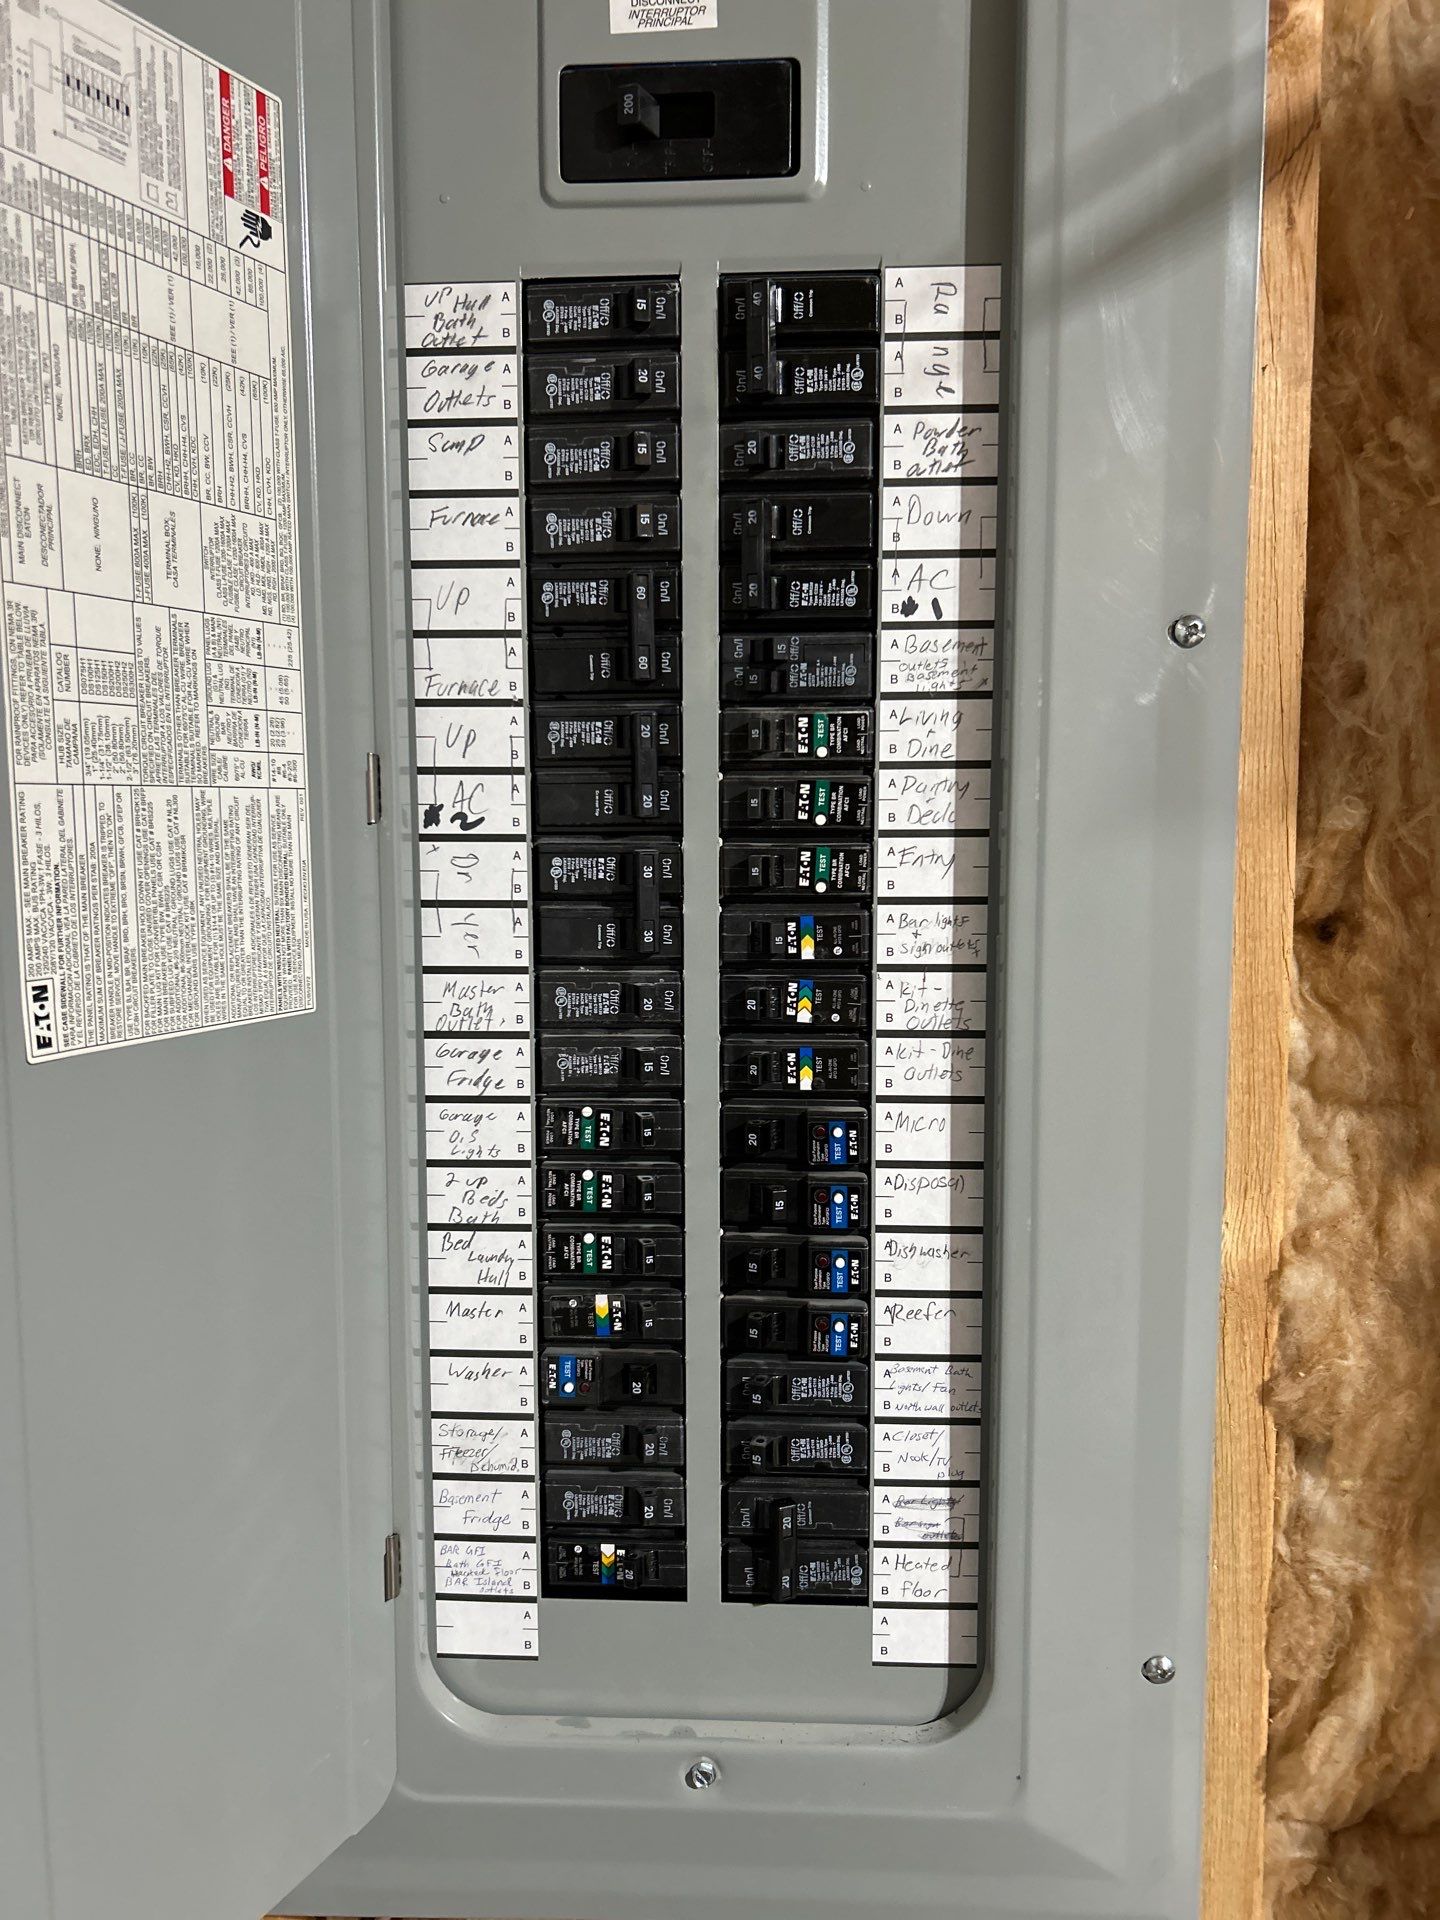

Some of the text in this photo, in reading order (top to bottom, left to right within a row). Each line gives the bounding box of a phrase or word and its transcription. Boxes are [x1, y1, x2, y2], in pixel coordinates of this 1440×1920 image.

[629, 6, 706, 19] INTERRUPTOR
[638, 16, 693, 28] PRINCIPAL
[624, 94, 634, 115] 200
[222, 98, 231, 152] DANGER
[258, 115, 268, 171] PELIGRO
[895, 278, 904, 288] A
[501, 292, 510, 302] A
[753, 292, 761, 306] 40
[434, 312, 477, 332] Bath
[895, 315, 902, 325] B
[502, 328, 511, 337] B
[421, 359, 495, 380] Garage
[638, 369, 648, 383] 20
[424, 385, 496, 413] Outlets
[913, 417, 982, 440] Powder
[748, 440, 757, 455] 20
[429, 506, 501, 528] Furnace
[907, 494, 972, 526] Down
[13, 478, 26, 564] MAIN DISCONNECT
[907, 563, 956, 590] AC
[637, 586, 646, 599] 60
[905, 634, 987, 656] Basement
[639, 656, 648, 670] 60
[425, 674, 500, 697] Furnace
[899, 707, 963, 731] Living
[907, 739, 954, 758] Dine
[453, 781, 488, 815] AC
[20, 826, 28, 865] BREAKER
[899, 845, 956, 879] Entry
[643, 865, 653, 878] 30
[899, 913, 929, 929] Bar
[55, 918, 64, 952] FURTHER
[443, 980, 505, 1000] Master
[515, 982, 524, 992] A
[644, 999, 652, 1010] 20
[516, 1014, 524, 1024] B
[435, 1043, 503, 1061] Garage
[942, 1042, 974, 1061] Dine
[446, 1069, 506, 1095] Fridge
[439, 1109, 497, 1126] Garage
[895, 1110, 946, 1133] Micro
[749, 1133, 757, 1146] 20
[446, 1173, 459, 1185] 2
[449, 1206, 500, 1224] Bath
[441, 1231, 476, 1252] Bed
[889, 1240, 970, 1260] Dishwasher
[446, 1301, 504, 1319] Master
[891, 1301, 956, 1323] Reefer
[449, 1364, 515, 1381] Washer
[890, 1363, 973, 1378] Basement Bath
[933, 1382, 956, 1393] Fan
[924, 1404, 945, 1413] wall
[892, 1429, 945, 1447] Closet/
[439, 1489, 502, 1504] Basement
[462, 1509, 511, 1531] Fridge
[440, 1544, 486, 1556] BAR GFI
[895, 1554, 952, 1572] Heated
[474, 1577, 512, 1586] Island
[523, 1611, 531, 1620] A
[880, 1617, 889, 1626] A
[524, 1640, 532, 1650] B
[880, 1646, 888, 1655] B
